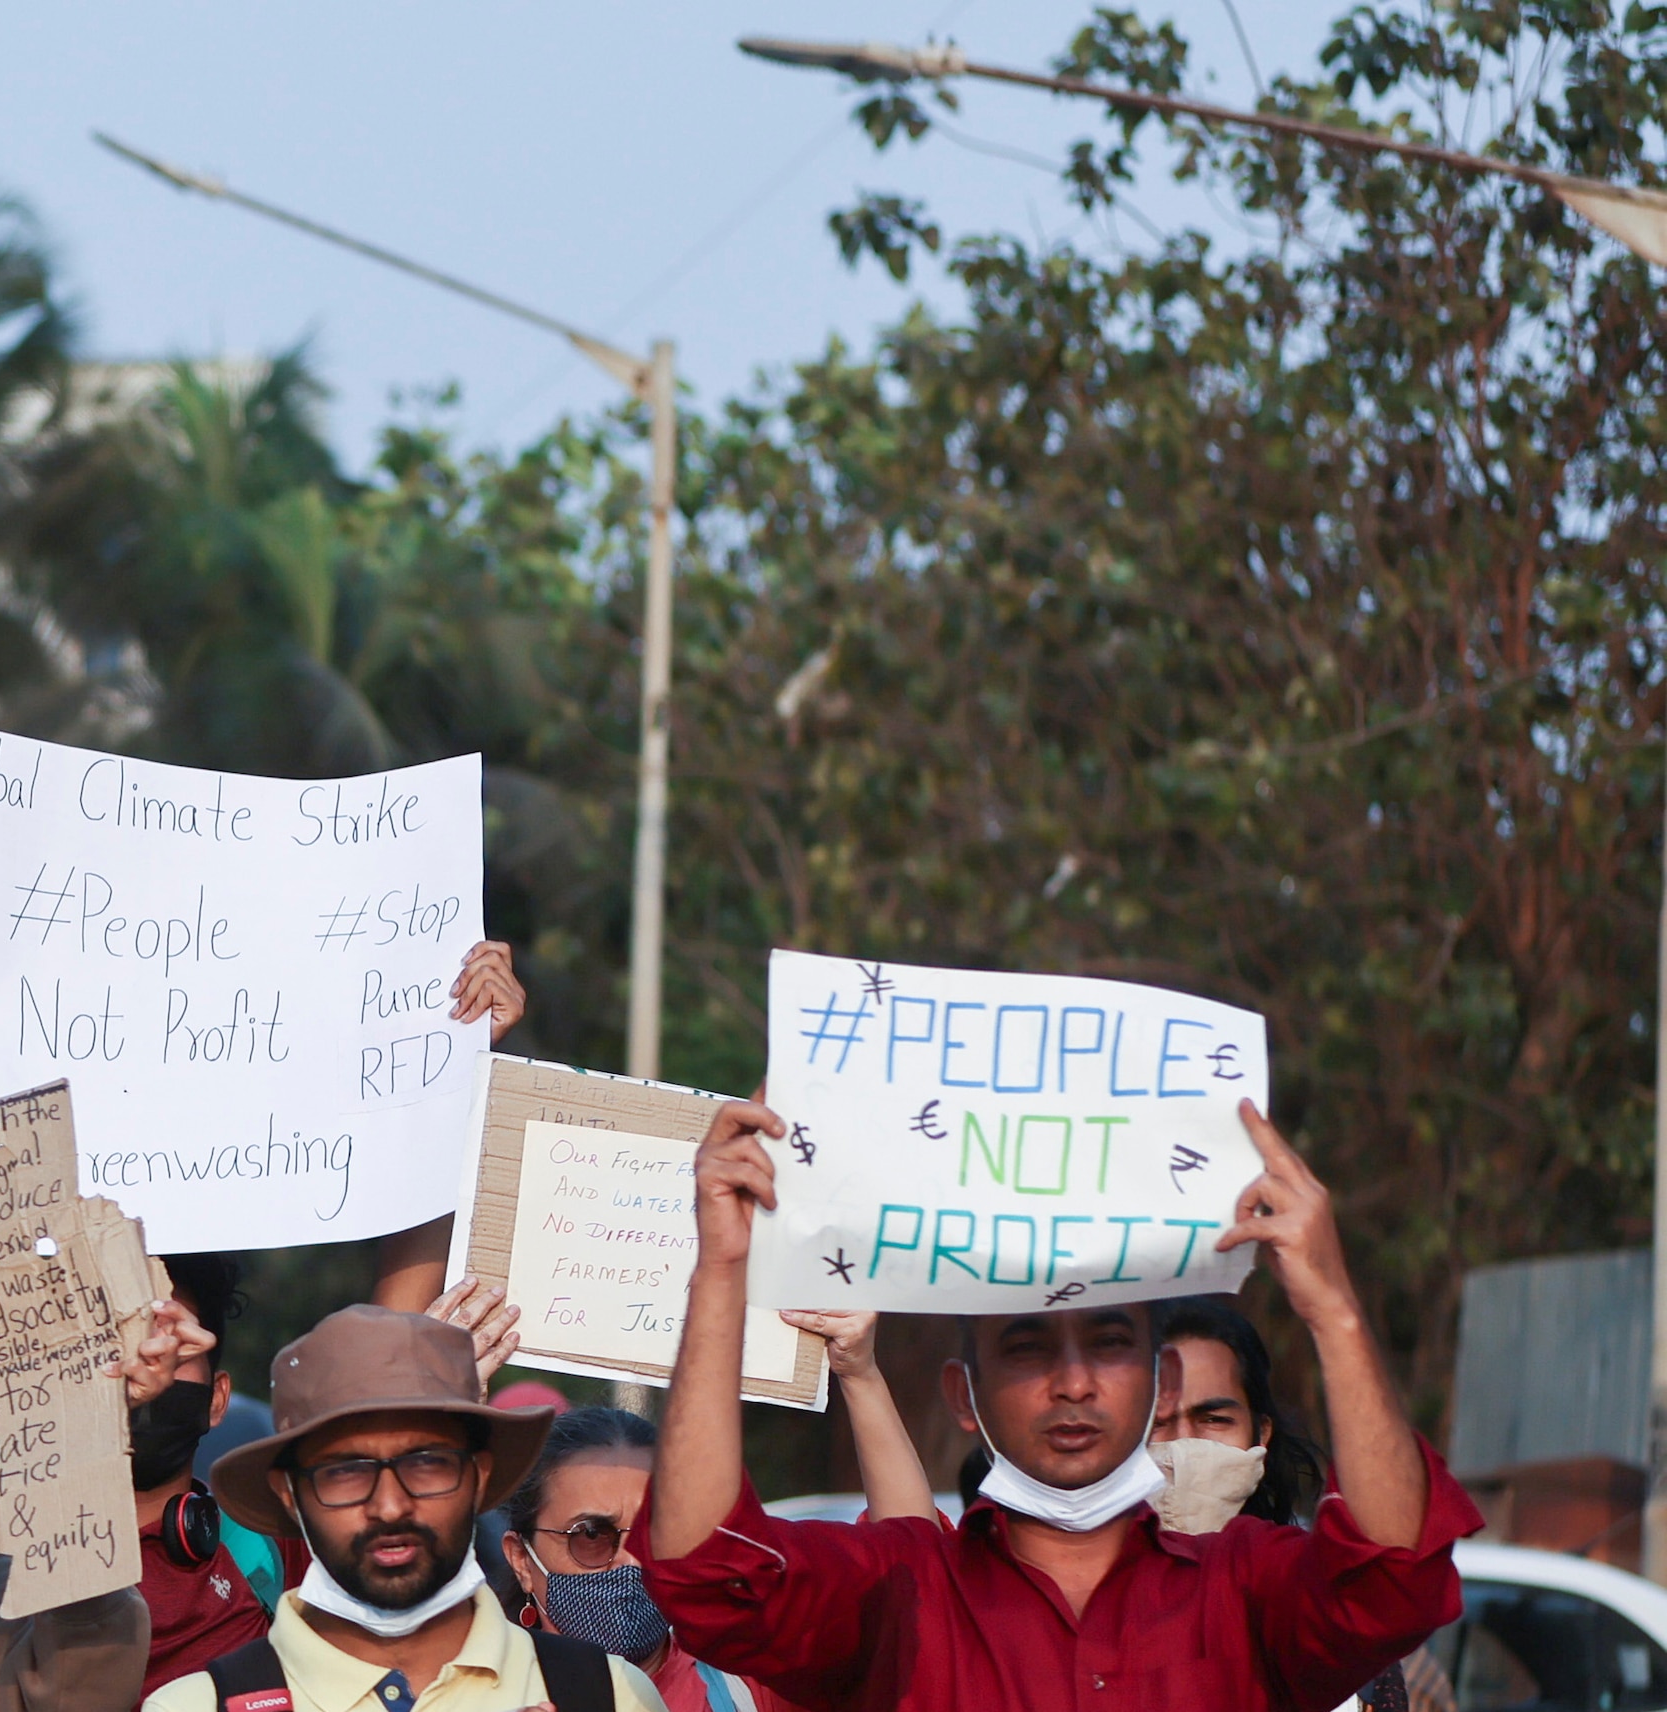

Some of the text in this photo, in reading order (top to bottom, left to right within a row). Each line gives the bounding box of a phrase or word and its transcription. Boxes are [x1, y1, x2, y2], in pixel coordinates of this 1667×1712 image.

[78, 757, 254, 842] Climate
[291, 775, 428, 848] Strike
[9, 862, 241, 979] #People
[314, 882, 462, 953] #Stop
[17, 974, 290, 1065] Not Profit
[360, 968, 447, 1027] Pune
[361, 1030, 454, 1101] RFD
[798, 989, 1214, 1098] #PEOPLE
[21, 1097, 62, 1126] the
[86, 1110, 355, 1221] reenwashing
[675, 1160, 698, 1178] FO
[958, 1110, 1132, 1197] NOT
[541, 1212, 576, 1236] NO
[553, 1175, 686, 1214] AND WATER
[550, 1256, 672, 1289] FARMERS'
[866, 1203, 1222, 1287] PROFIT
[543, 1296, 588, 1328] FOR
[8, 1493, 36, 1538] &
[24, 1503, 116, 1575] equity
[245, 1696, 289, 1711] Lenovo
